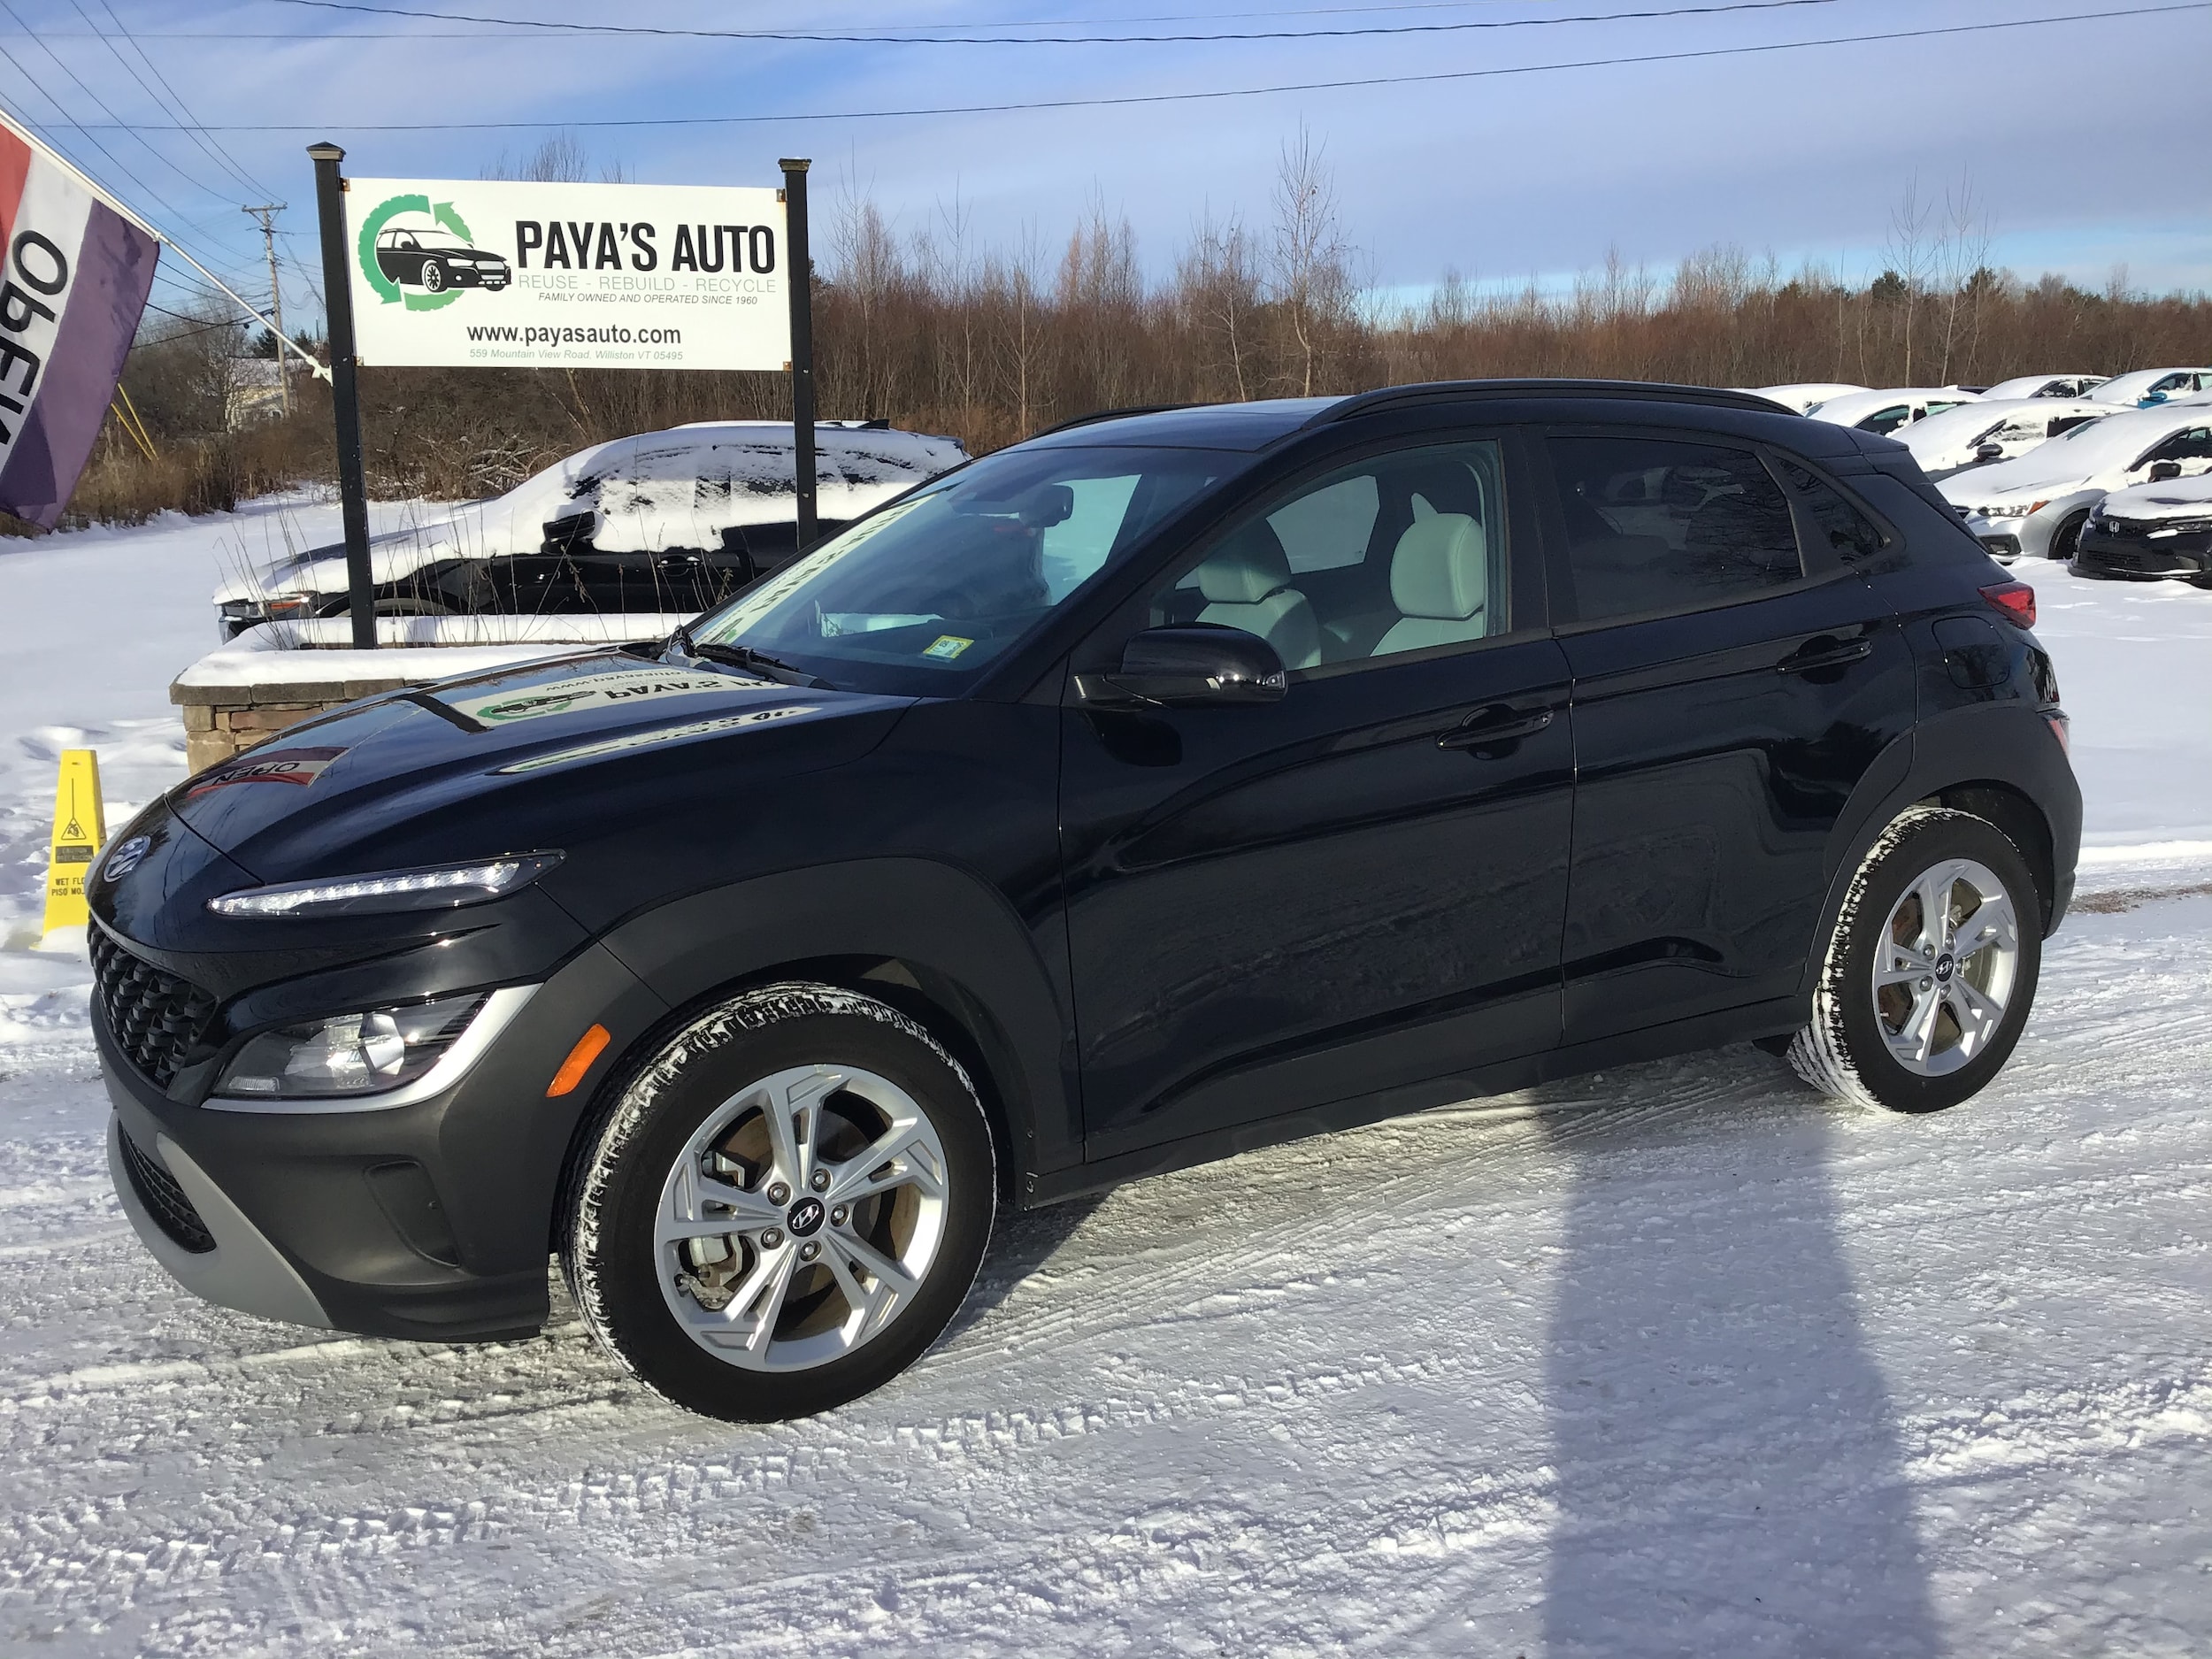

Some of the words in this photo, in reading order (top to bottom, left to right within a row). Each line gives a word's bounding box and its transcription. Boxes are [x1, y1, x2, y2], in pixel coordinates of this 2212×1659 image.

[516, 220, 657, 272] PAYA'S
[672, 224, 775, 273] AUTO
[518, 274, 578, 289] REUSE
[599, 276, 675, 291] REBUILD
[695, 278, 776, 293] RECYCLE
[538, 292, 575, 302] FAMILY
[577, 293, 617, 303] OWNED
[619, 294, 641, 303] AND
[643, 294, 699, 304] OPERATED
[702, 295, 732, 304] SINCE
[736, 296, 758, 305] 1960
[466, 324, 681, 348] www.payasauto.com
[469, 349, 488, 358] 559
[490, 349, 535, 358] Mountain
[538, 349, 561, 359] View
[595, 350, 634, 360] Williston
[653, 351, 683, 360] 05495
[212, 763, 300, 786] OPEN
[51, 887, 68, 896] PISO
